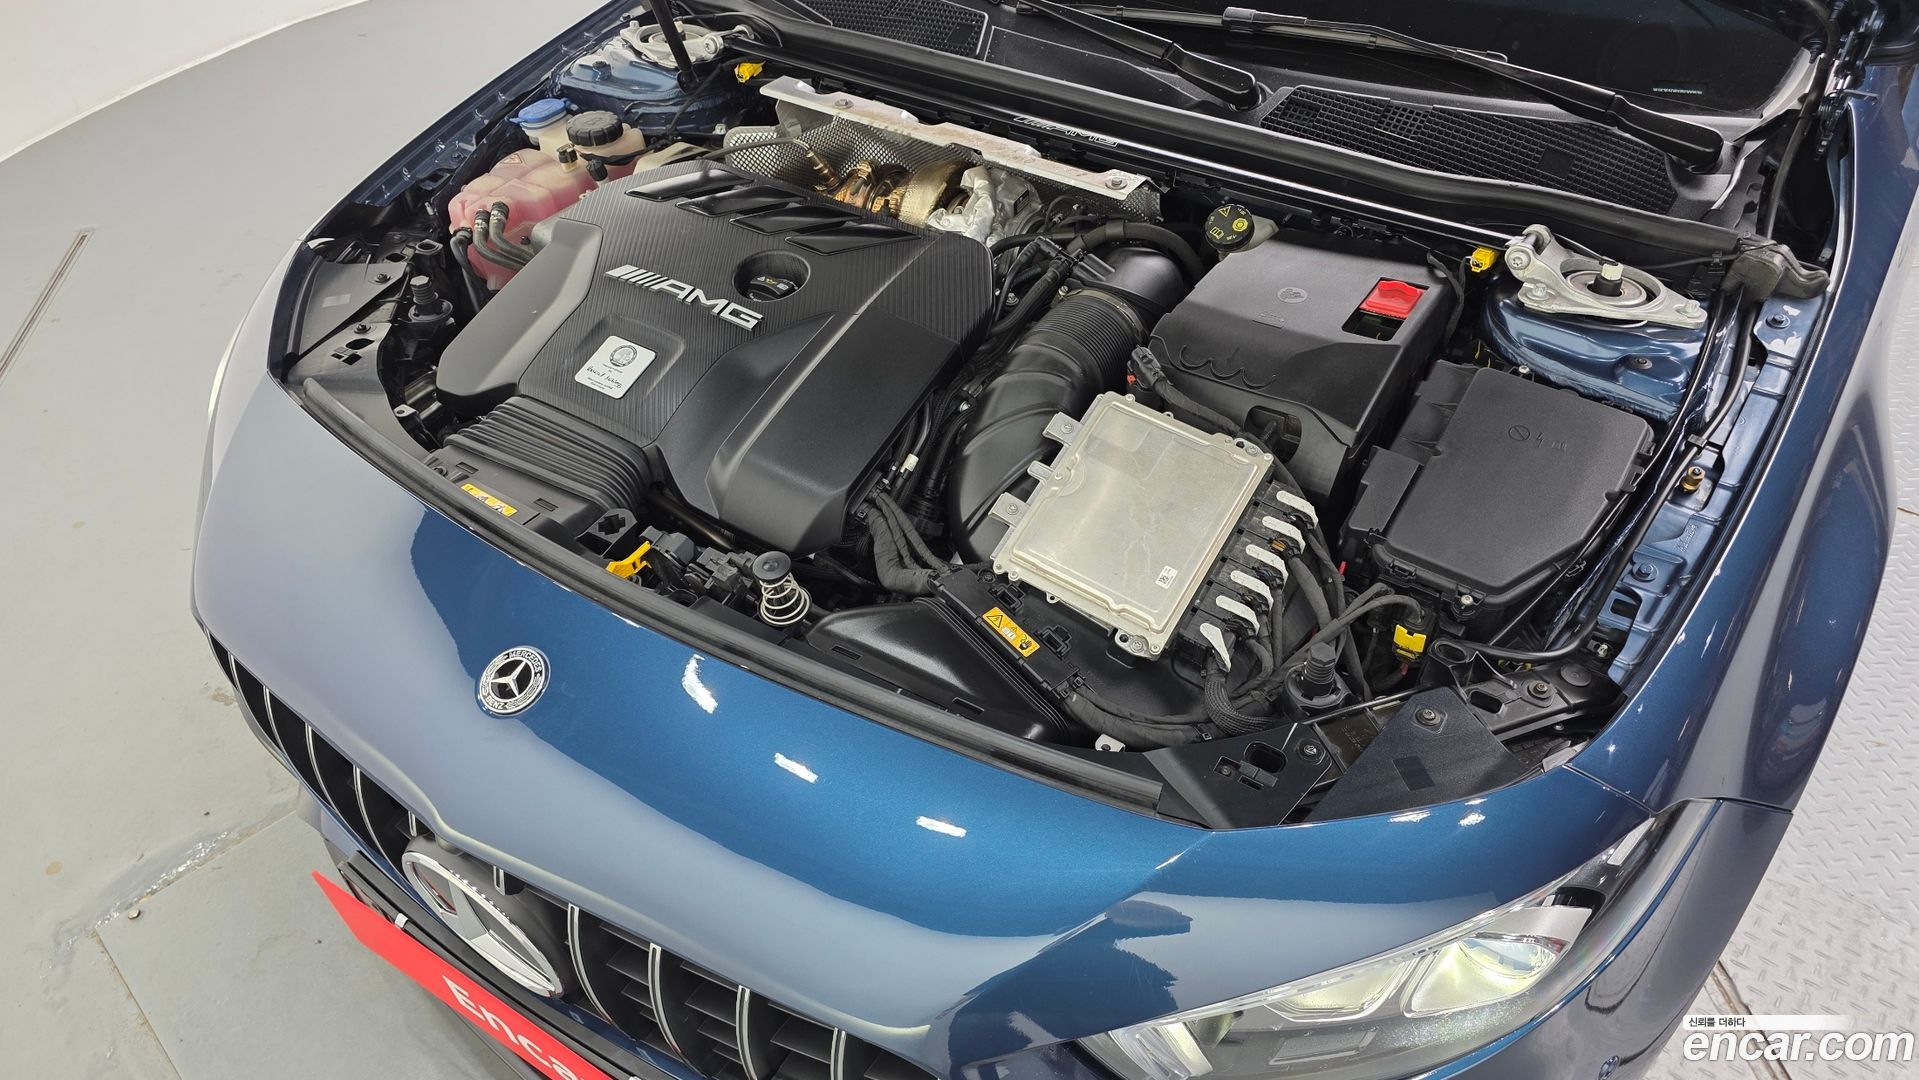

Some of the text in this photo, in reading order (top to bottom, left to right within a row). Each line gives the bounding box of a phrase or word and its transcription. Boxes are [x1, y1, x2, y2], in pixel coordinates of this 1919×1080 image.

[646, 277, 764, 331] AMG
[508, 650, 543, 673] MERCEDES
[485, 696, 505, 710] BENZ
[442, 974, 584, 1080] Enca
